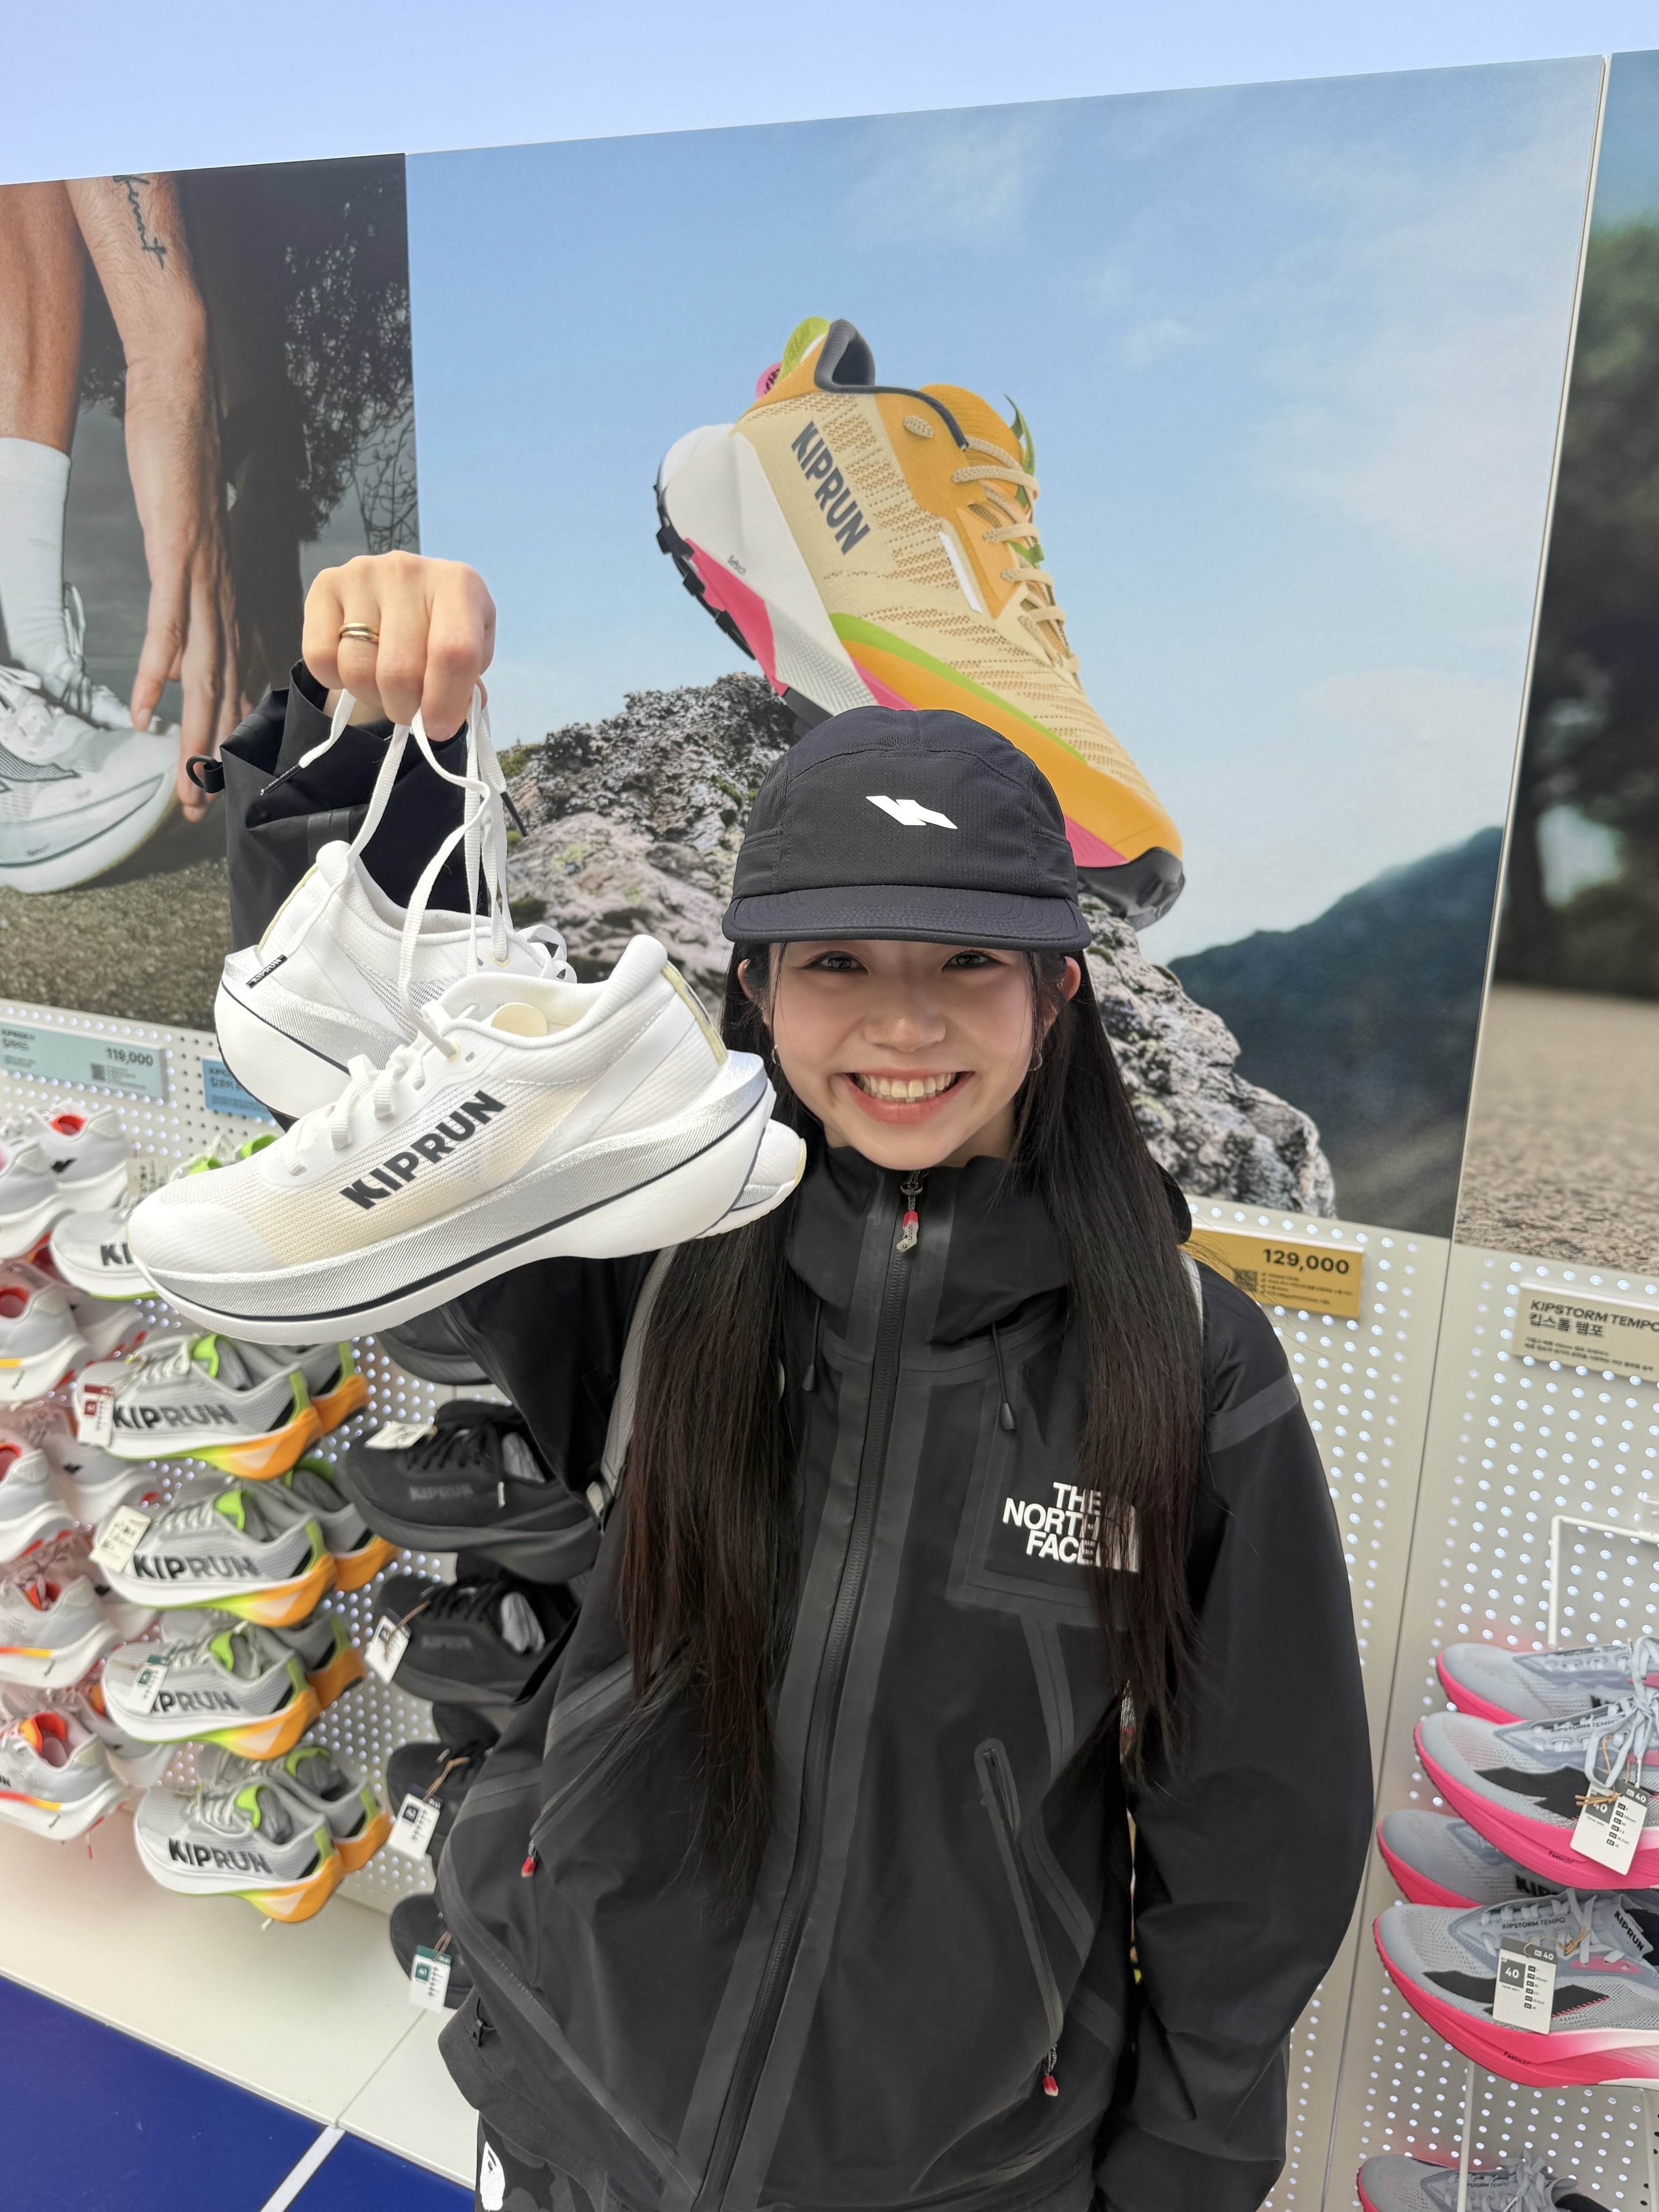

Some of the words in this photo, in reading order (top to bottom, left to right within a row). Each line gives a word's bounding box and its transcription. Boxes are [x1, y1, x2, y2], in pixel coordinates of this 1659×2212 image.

[791, 420, 871, 555] KIPRUN
[106, 1047, 154, 1067] 119,000
[339, 1090, 507, 1210] KIPRUN
[1263, 1248, 1349, 1274] 129,000
[1530, 1300, 1608, 1322] KIPSTORM
[1611, 1314, 1659, 1333] TEMPO
[114, 1405, 238, 1428] KIPRUN
[1053, 1482, 1101, 1515] THE
[1002, 1498, 1100, 1541] NORTH
[1026, 1529, 1093, 1566] FACE
[133, 1556, 260, 1579] KIPRUN
[152, 1691, 240, 1711] IPRUN
[1593, 1802, 1608, 1813] 40
[1635, 1793, 1646, 1803] 40
[169, 1837, 273, 1874] KIPRUN
[1515, 1875, 1559, 1898] KIP
[1502, 1920, 1538, 1929] KIPSTORM
[1540, 1917, 1565, 1925] TEMPO
[1614, 1910, 1644, 1951] KIPRUN
[1543, 1952, 1554, 1961] 40
[1505, 1967, 1519, 1978] 40
